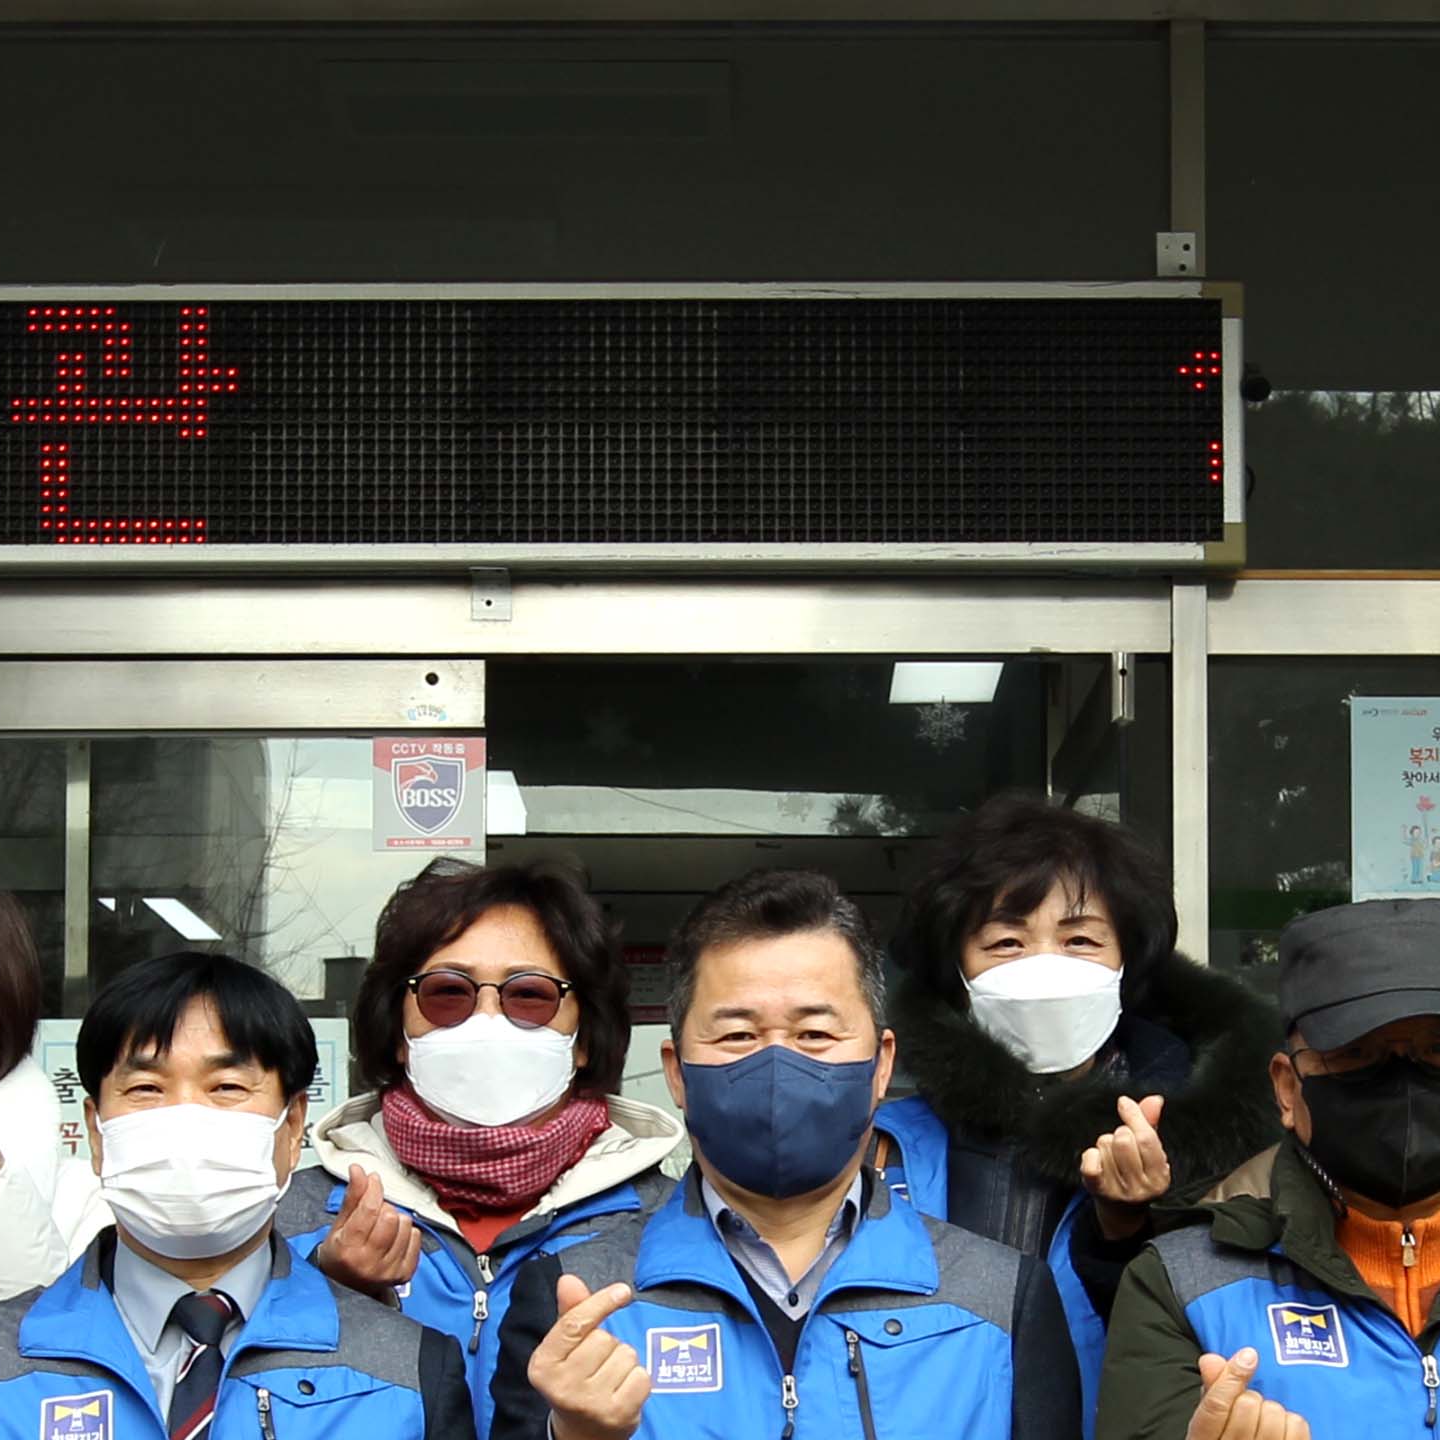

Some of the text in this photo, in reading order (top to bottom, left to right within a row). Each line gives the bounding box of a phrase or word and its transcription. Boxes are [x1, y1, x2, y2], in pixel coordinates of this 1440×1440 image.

[392, 743, 426, 754] CCTV
[1409, 747, 1439, 767] 복지
[1402, 771, 1440, 788] 찾아서
[402, 788, 456, 808] BOSS
